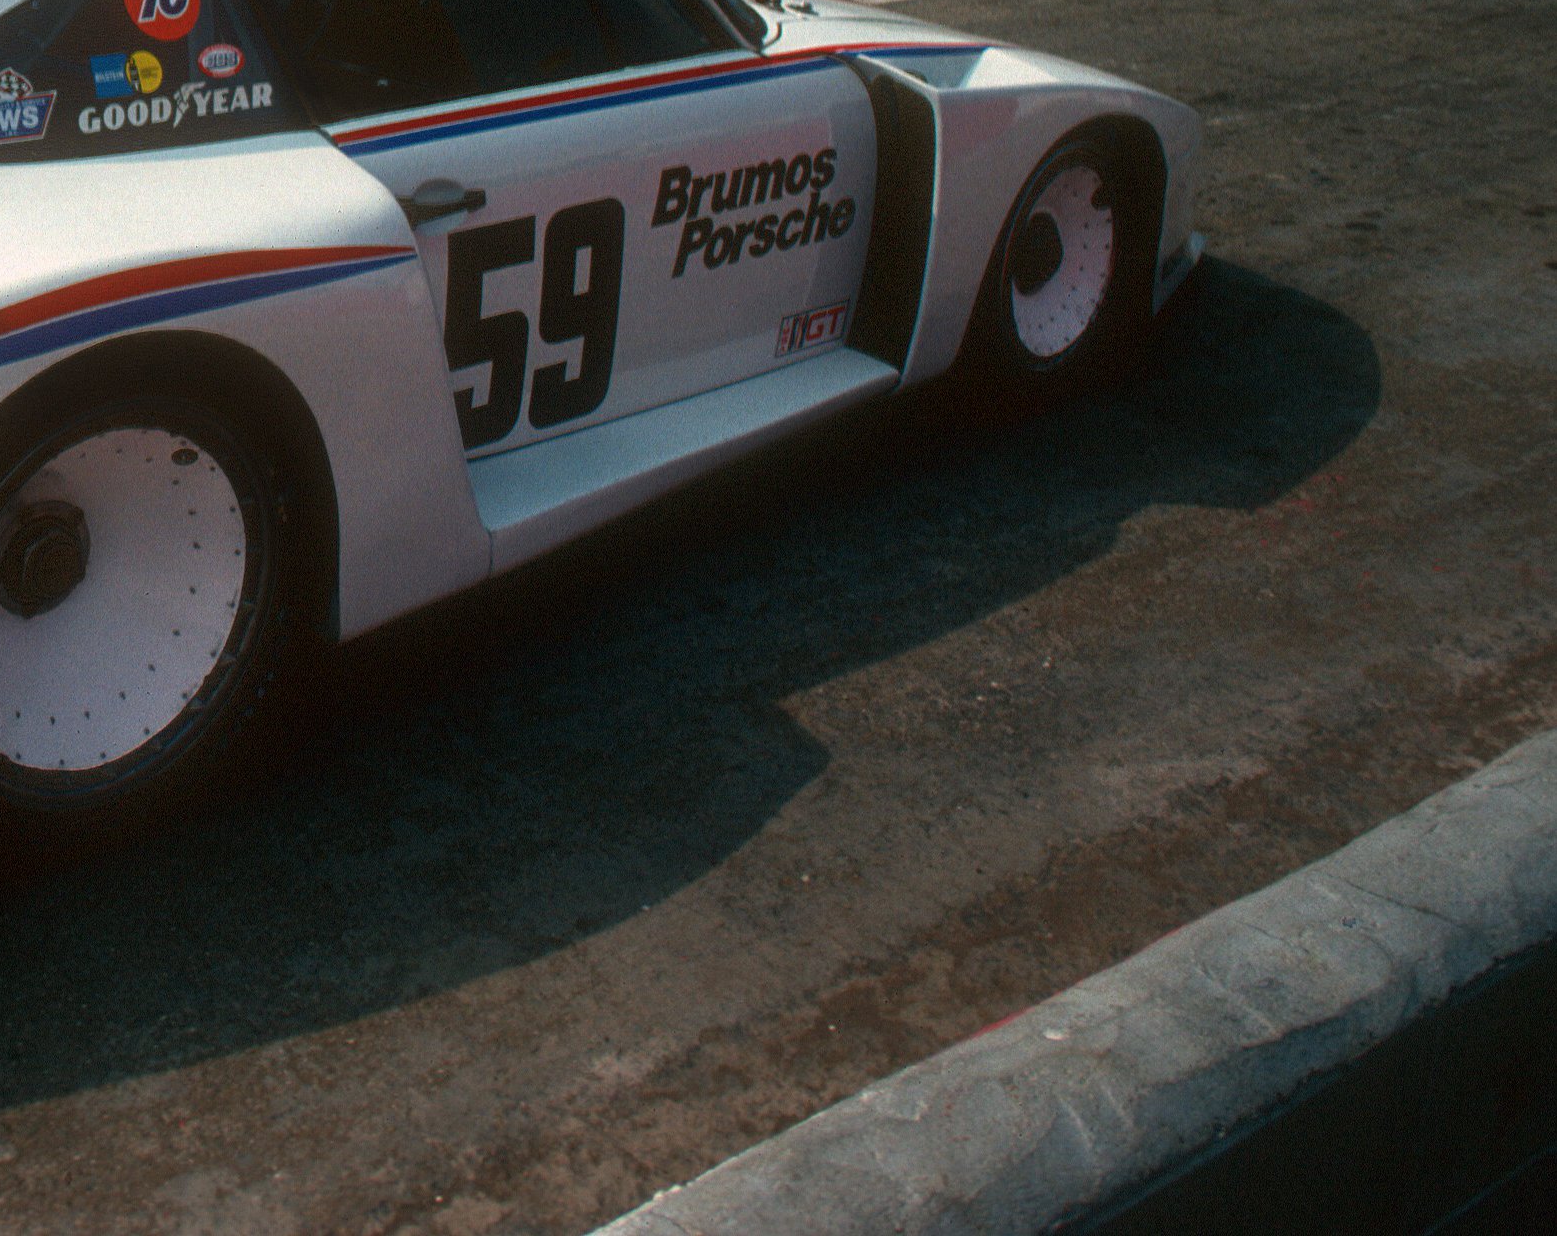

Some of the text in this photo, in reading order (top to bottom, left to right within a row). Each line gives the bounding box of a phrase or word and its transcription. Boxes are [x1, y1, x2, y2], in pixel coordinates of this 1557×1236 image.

[78, 81, 273, 135] GOODYEAR
[651, 148, 838, 228] Brumos
[672, 190, 857, 279] Porsche
[443, 196, 626, 451] 59
[805, 306, 846, 342] GT
